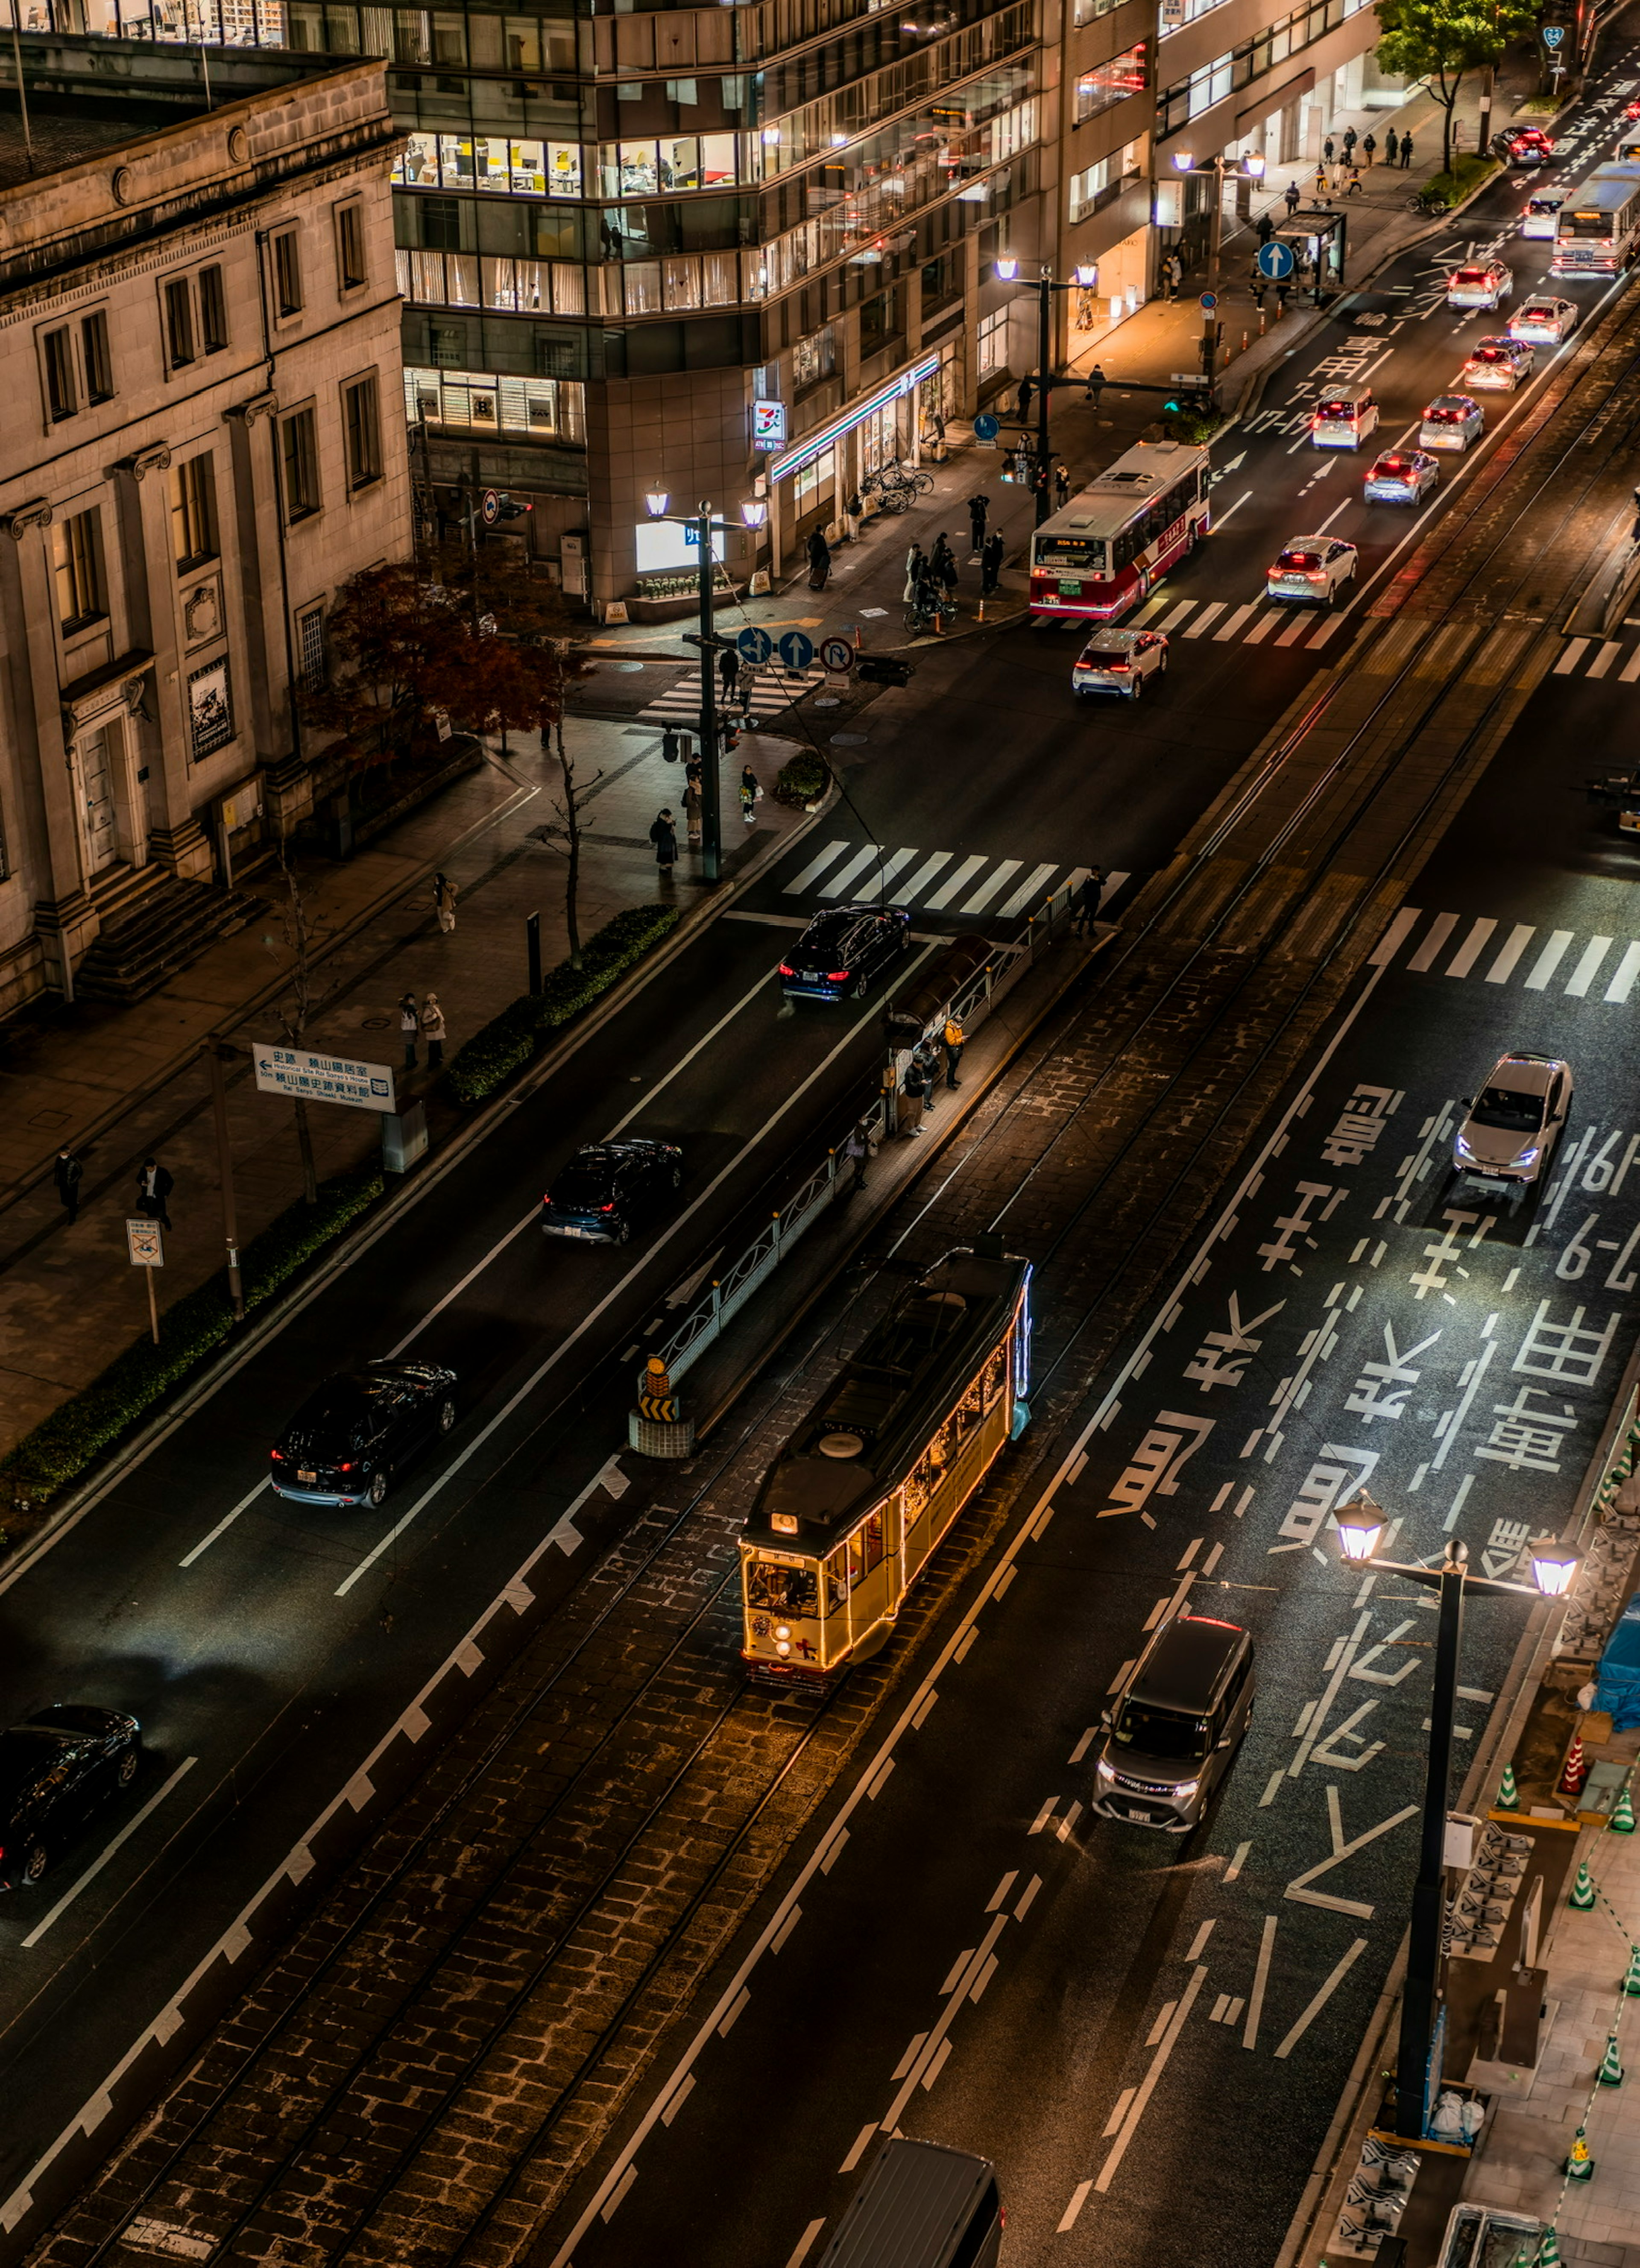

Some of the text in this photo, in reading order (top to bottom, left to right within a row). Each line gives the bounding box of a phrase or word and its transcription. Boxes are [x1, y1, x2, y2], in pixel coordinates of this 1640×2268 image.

[1550, 78, 1640, 156] 追突注意
[1308, 336, 1389, 380] 専用
[273, 1051, 296, 1064] 史跡
[274, 1063, 301, 1074] Historical
[302, 1067, 314, 1076] Site
[326, 1071, 348, 1081] Sanyo's
[296, 1087, 313, 1095] Sanyo
[316, 1090, 337, 1099] Shiseki
[340, 1094, 363, 1103] Museum
[1555, 1213, 1640, 1292] 7-9
[1096, 1083, 1406, 1531] 追突注意
[1473, 1298, 1622, 1474] 専用
[1209, 1785, 1421, 2060] バス
